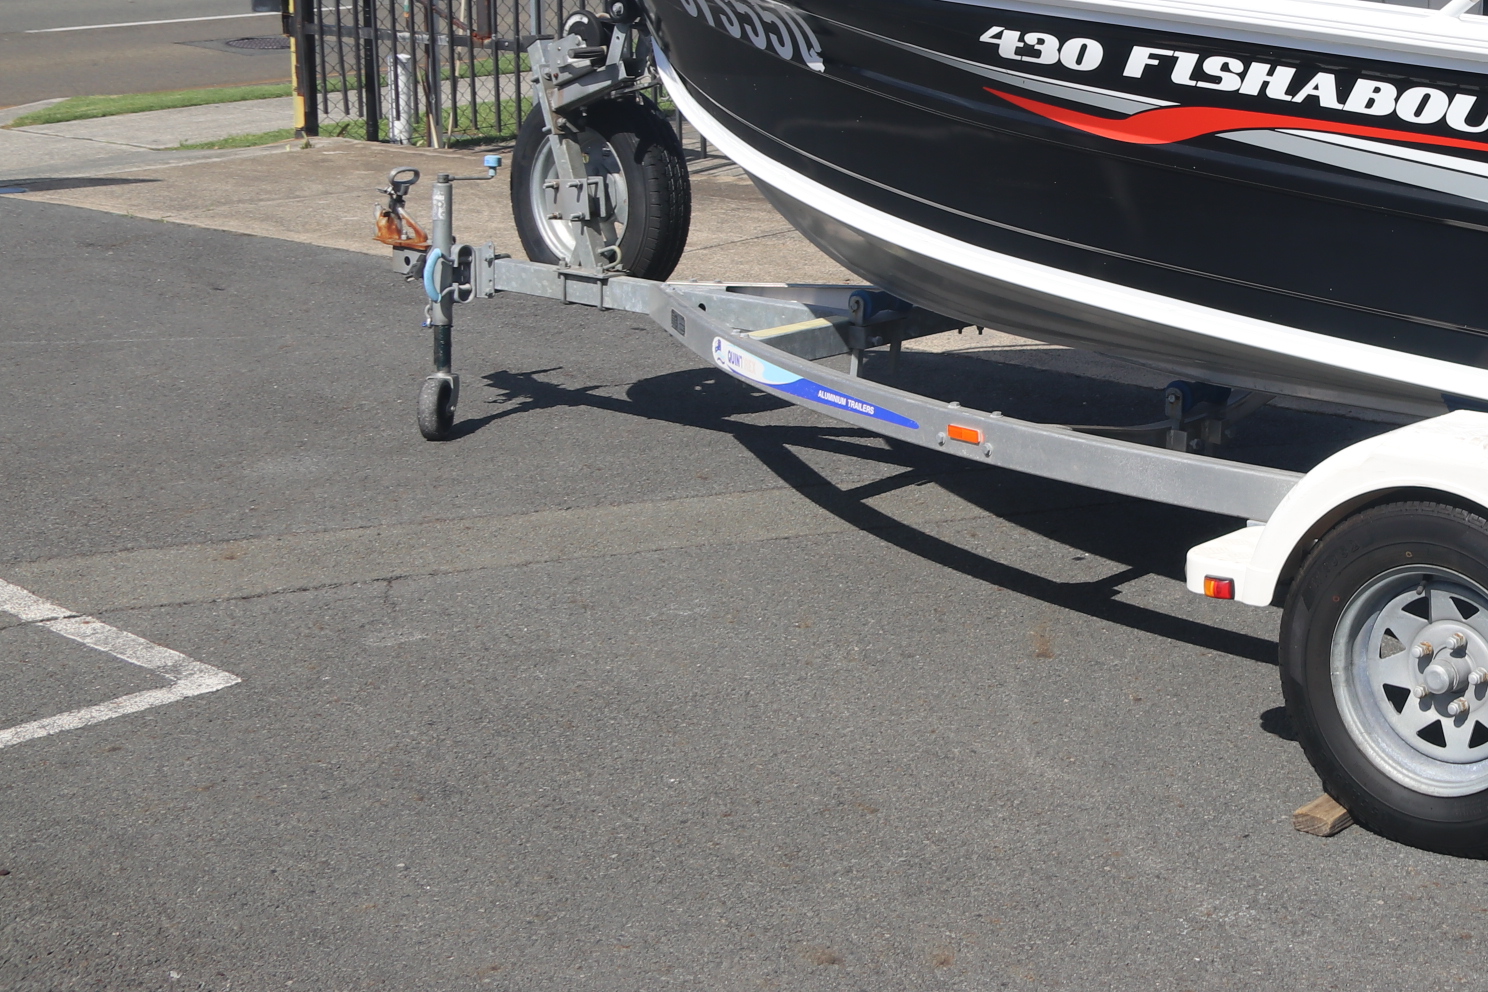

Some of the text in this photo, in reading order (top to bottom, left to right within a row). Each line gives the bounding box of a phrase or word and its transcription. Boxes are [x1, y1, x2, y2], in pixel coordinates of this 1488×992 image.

[979, 26, 1104, 71] 430
[818, 390, 875, 415] ALUMINIUM TRAILERS
